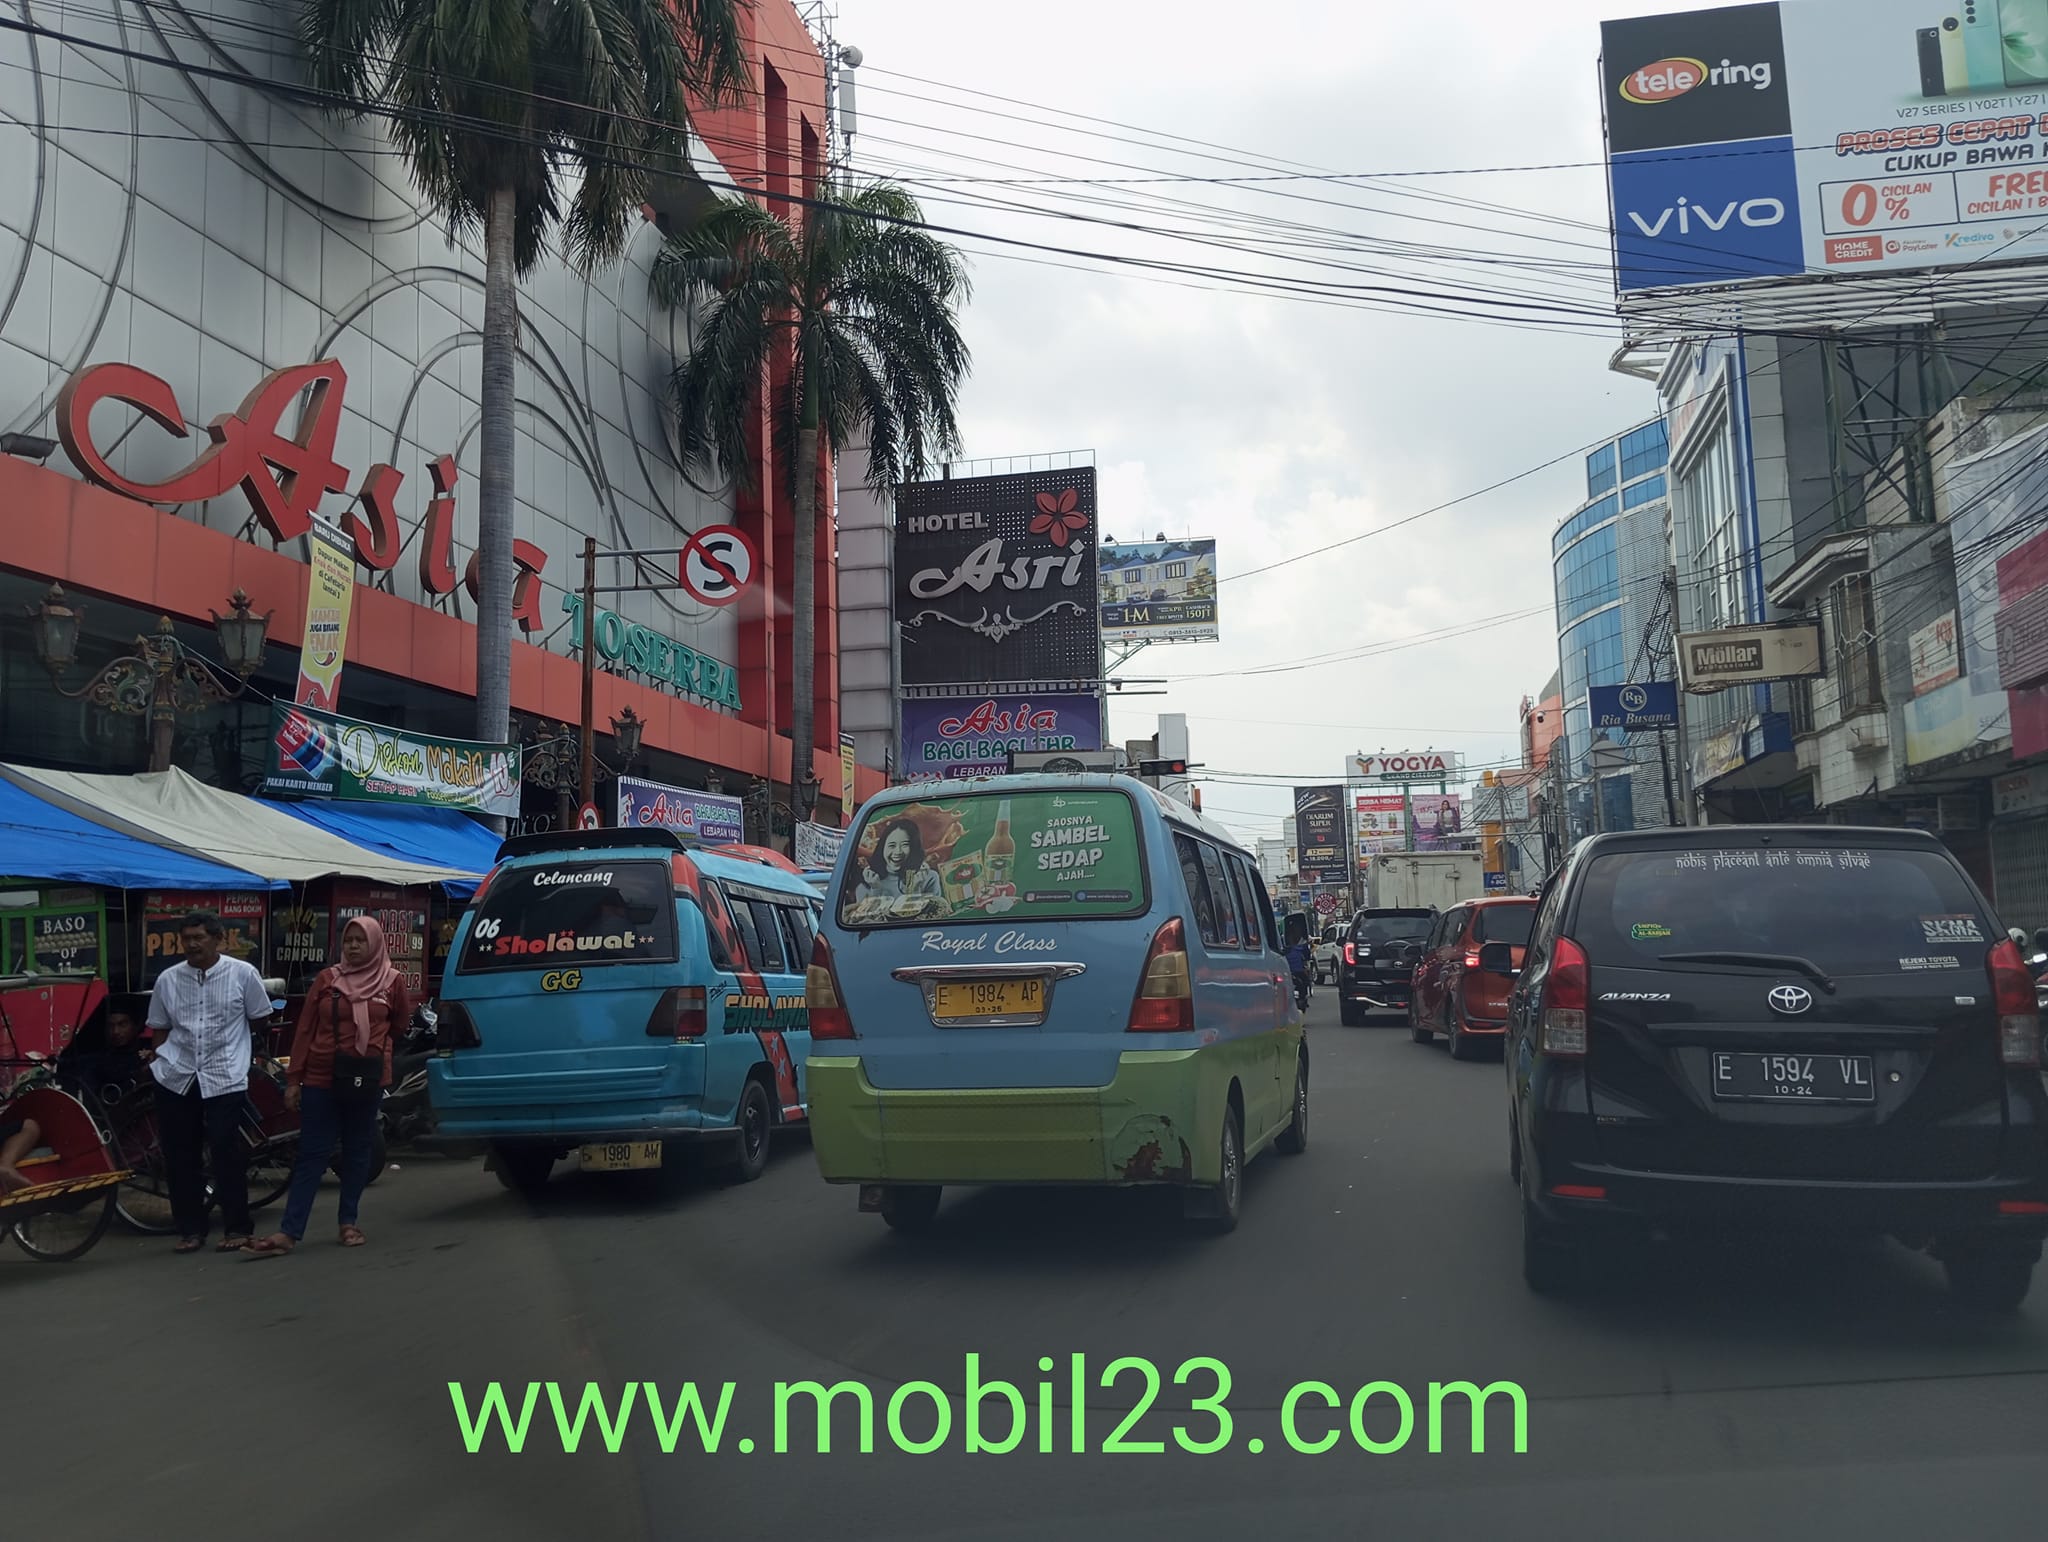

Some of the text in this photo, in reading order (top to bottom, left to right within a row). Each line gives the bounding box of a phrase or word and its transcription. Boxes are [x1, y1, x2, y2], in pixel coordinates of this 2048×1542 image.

[1634, 58, 1772, 95] tele ring
[1896, 107, 1919, 118] V27
[1923, 102, 1966, 115] SERIES
[2015, 94, 2039, 106] Y27
[1836, 124, 1944, 157] PROSES
[1946, 114, 2036, 144] CEPAT
[1884, 152, 1958, 172] CUKUP
[1966, 143, 2034, 165] BAWA
[1881, 182, 1932, 198] CICILAN
[1628, 196, 1785, 238] vivo
[1967, 198, 2022, 215] CICILAN
[1834, 240, 1868, 251] HOME
[1834, 247, 1873, 260] CREDIT
[56, 358, 548, 631] Asia
[908, 511, 989, 533] HOTEL
[909, 537, 1085, 599] Asri
[562, 593, 742, 711] TOSERBA
[1696, 645, 1758, 665] Möllar
[938, 700, 1058, 738] Asia
[1600, 712, 1672, 726] Ria Busana
[923, 738, 1026, 762] BAGI-BAGI
[952, 766, 1007, 778] LEBARAN
[1378, 755, 1446, 772] YOGYA
[307, 781, 333, 792] MEMBER
[638, 792, 694, 828] Asia
[1047, 816, 1093, 828] SAOSNYA
[1031, 825, 1110, 848] SAMBEL
[1037, 847, 1103, 870] SEDAP
[533, 871, 614, 886] Celancang
[42, 916, 86, 934] BASO
[474, 918, 501, 938] 06
[285, 933, 314, 947] NASI
[411, 936, 424, 950] 99
[494, 931, 635, 955] Sholawat
[920, 930, 1057, 955] Royal Class
[276, 946, 325, 962] CAMPUR
[541, 970, 583, 992] GG
[938, 981, 1039, 1006] E 1984 AP
[1598, 992, 1671, 1001] AVANZA
[1718, 1056, 1868, 1084] E 1594 VL
[602, 1145, 631, 1162] 1980
[644, 1143, 660, 1159] AW
